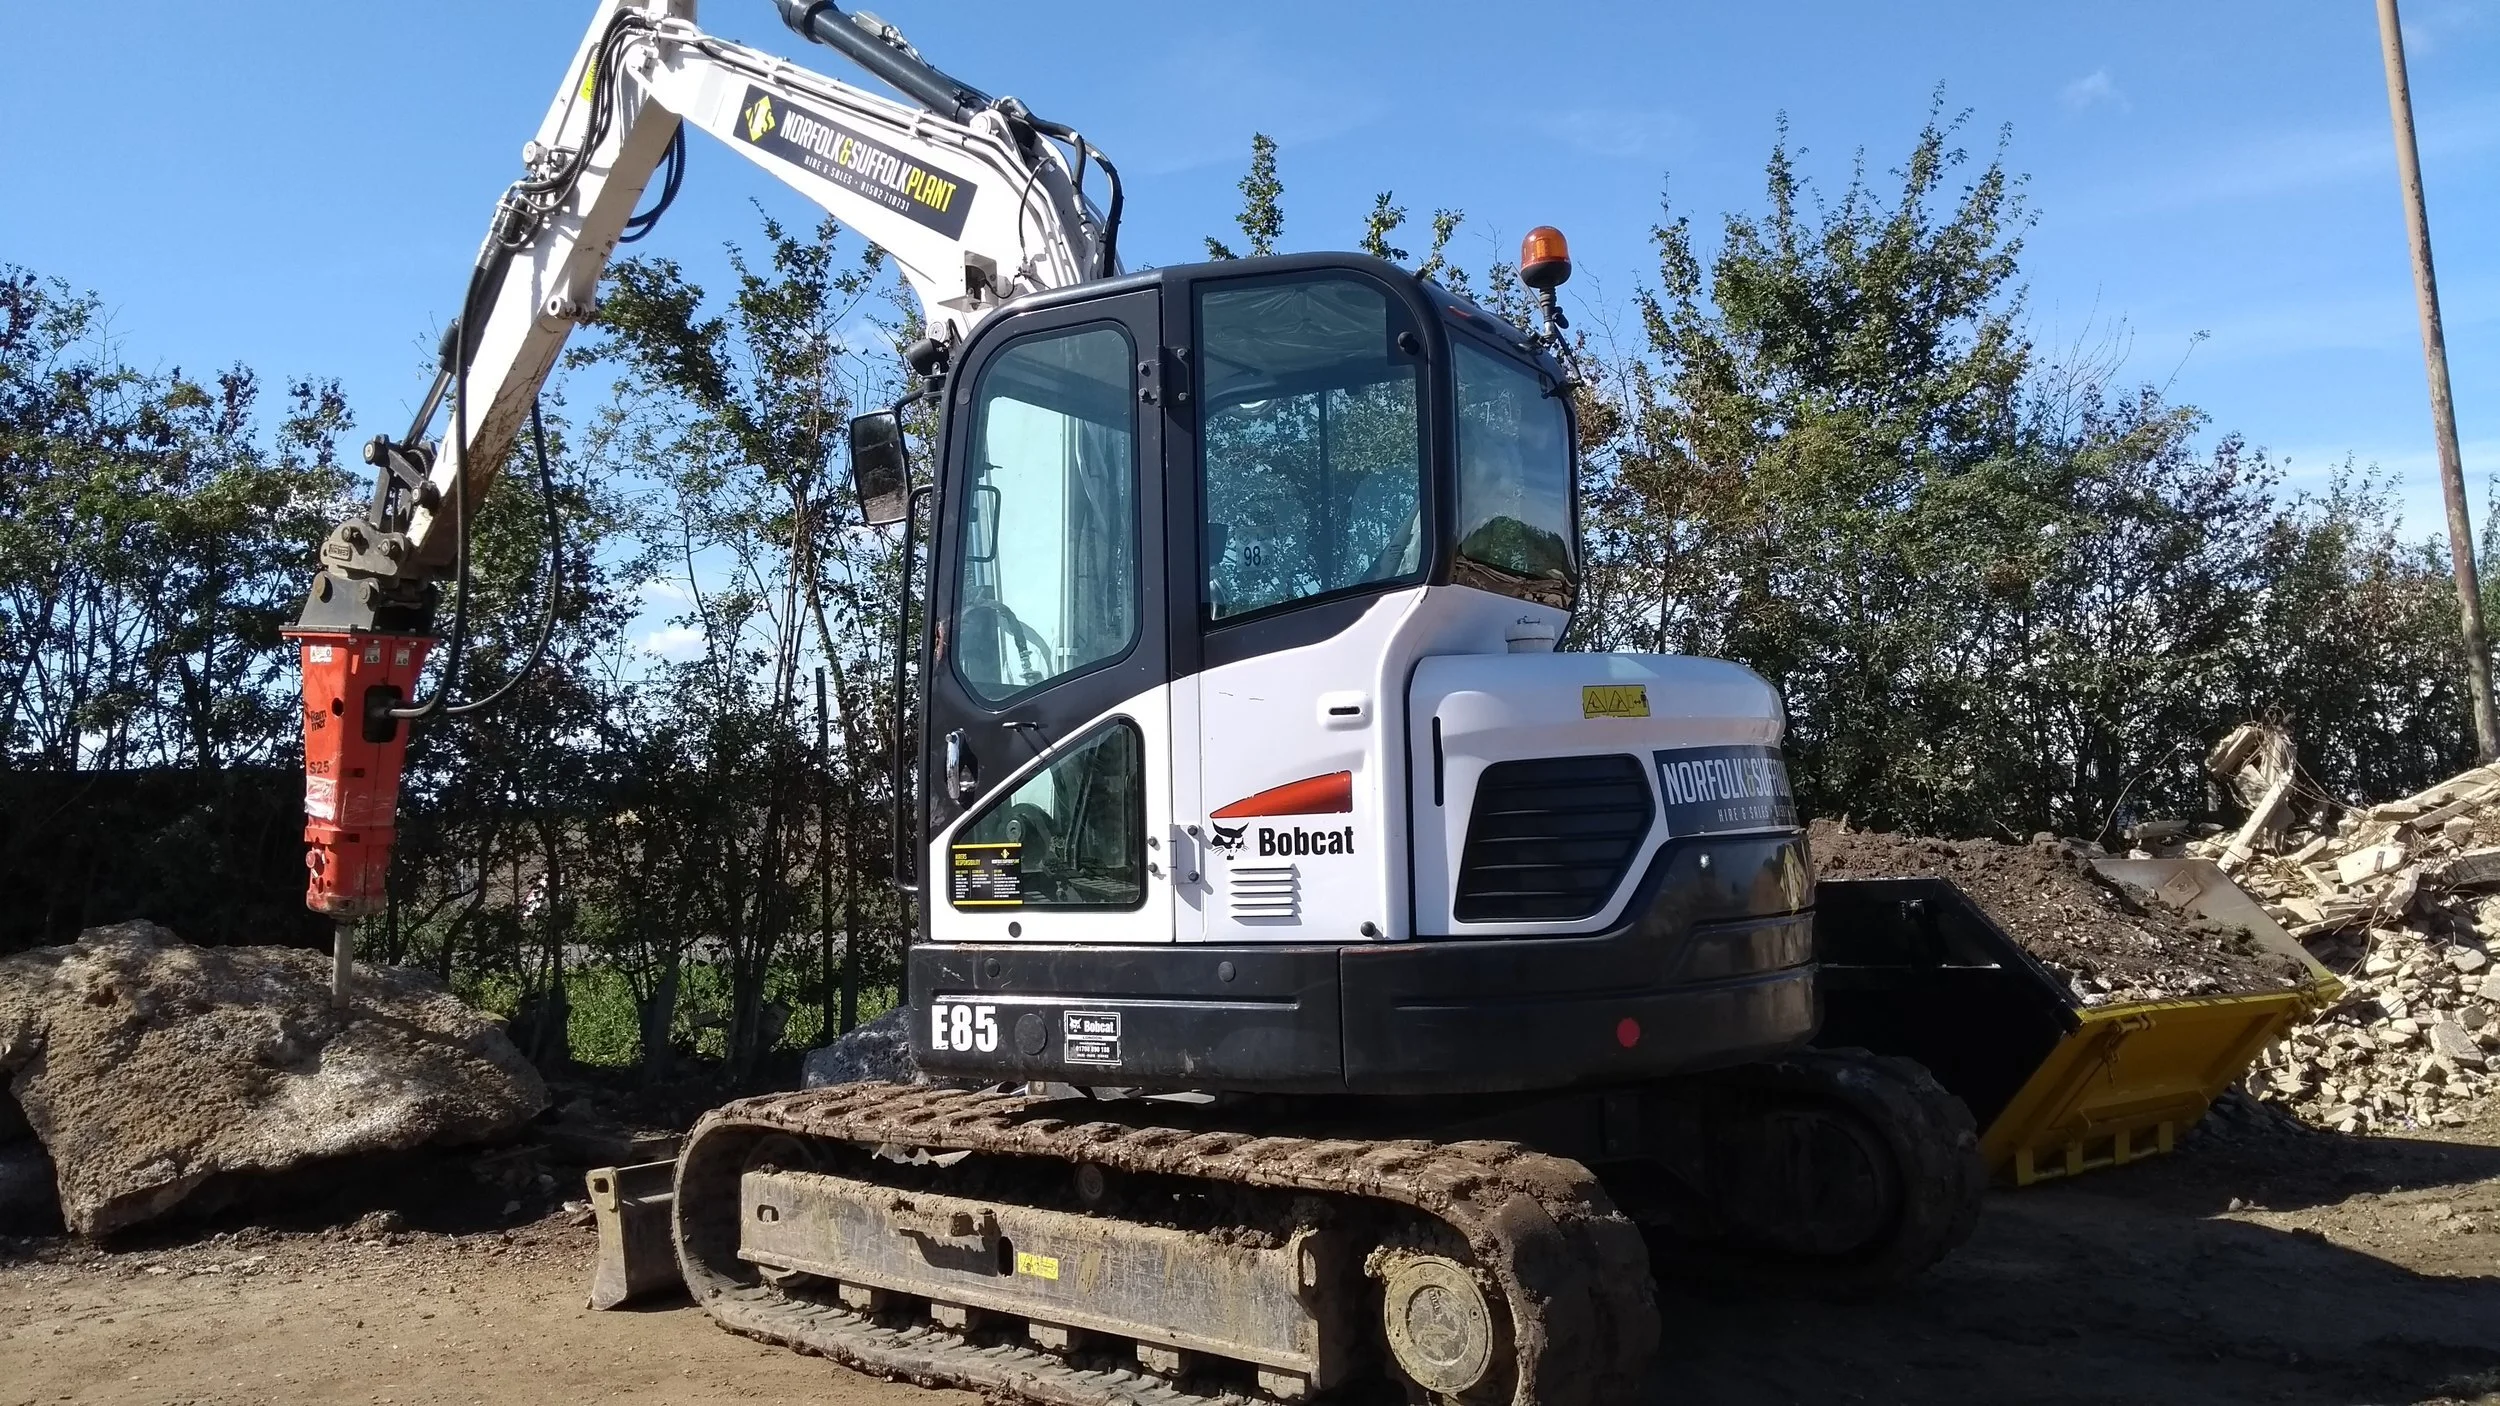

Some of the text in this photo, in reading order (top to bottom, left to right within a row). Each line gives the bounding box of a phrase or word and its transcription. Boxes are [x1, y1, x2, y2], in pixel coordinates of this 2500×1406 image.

[804, 154, 822, 171] HIRE
[823, 164, 829, 174] &
[830, 167, 852, 185] SALES
[1243, 545, 1261, 567] 98
[309, 761, 330, 774] S25
[1717, 807, 1739, 822] HIRE
[1748, 805, 1769, 819] SALES
[1258, 826, 1355, 857] Bobcat
[931, 1004, 998, 1052] E85
[1083, 1020, 1114, 1033] Bobcat
